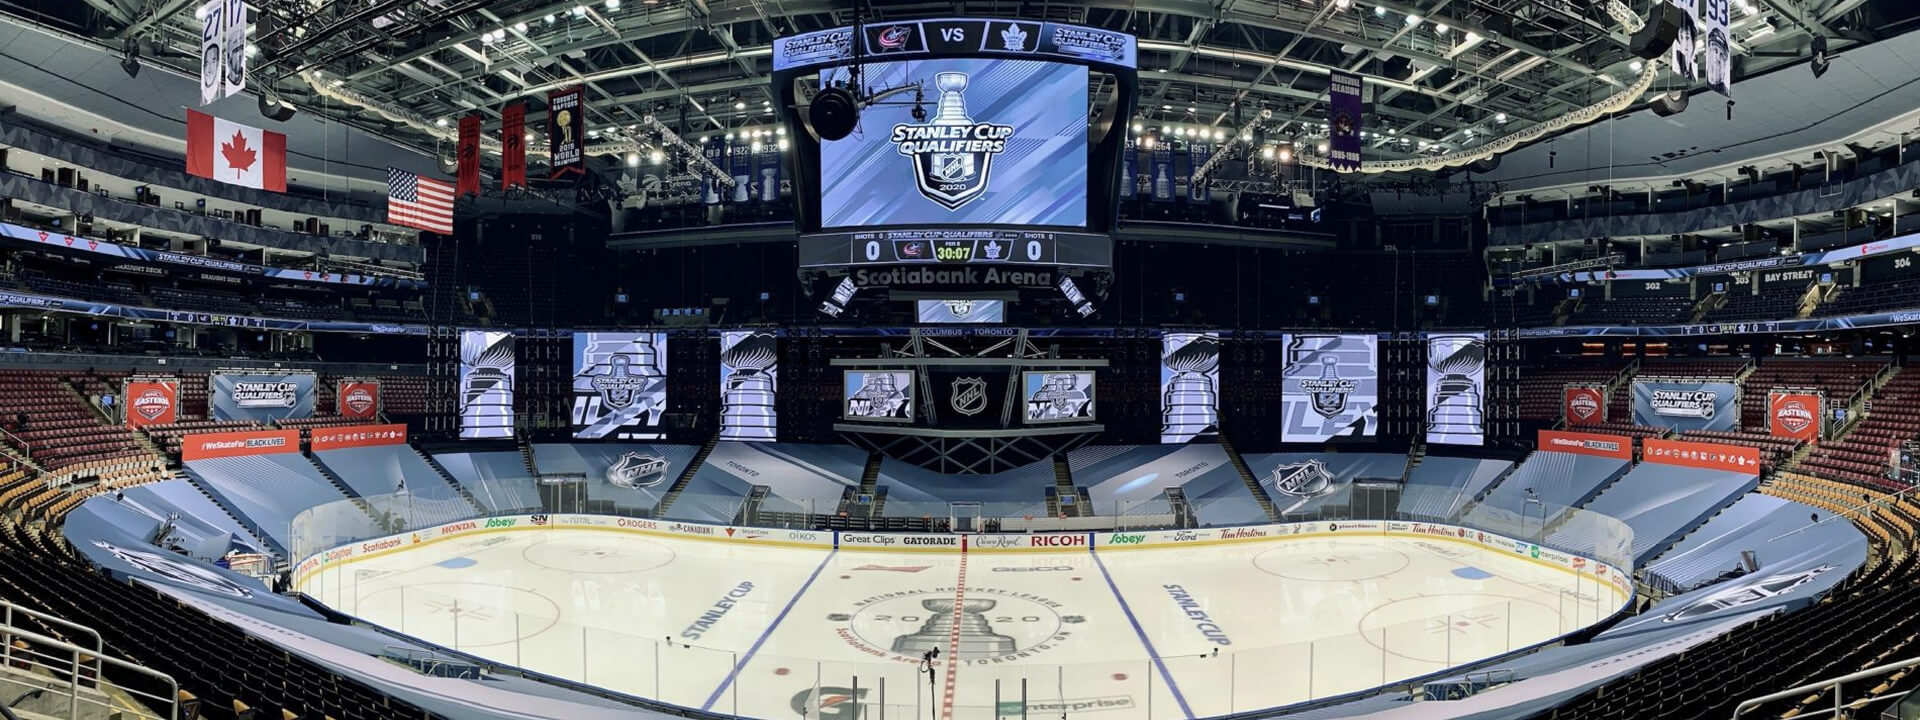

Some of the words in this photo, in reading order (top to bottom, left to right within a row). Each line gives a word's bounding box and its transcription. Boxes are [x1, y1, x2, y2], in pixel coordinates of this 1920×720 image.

[204, 8, 221, 43] 27
[941, 27, 965, 42] VS
[1056, 28, 1102, 42] STANLEY
[1103, 35, 1126, 46] CUP
[785, 34, 830, 49] STANLEY
[1054, 37, 1110, 50] QUALIFIERS
[893, 125, 973, 141] STANLEY
[974, 124, 1013, 140] CUP
[900, 140, 1004, 154] QUALIFIERS
[554, 149, 580, 160] WORLD
[866, 241, 880, 261] 0
[937, 247, 970, 259] 30:07
[1027, 241, 1041, 261] 0
[1895, 259, 1911, 269] 304
[857, 267, 978, 285] Scotiabank
[984, 268, 1050, 285] Arena
[1765, 273, 1781, 282] BAY
[1783, 270, 1814, 281] STREET
[1645, 282, 1660, 290] 302
[921, 328, 962, 336] COLUMBUS
[974, 328, 1013, 336] TORONTO
[235, 382, 278, 391] STANLEY
[278, 382, 297, 392] CUP
[235, 392, 283, 400] QUALIFIERS
[958, 388, 981, 407] NHL
[1653, 391, 1693, 400] STANLEY
[1694, 391, 1716, 401] CUP
[1652, 400, 1701, 409] QUALIFIERS
[247, 439, 268, 448] BLACK
[268, 438, 285, 446] LIVES
[1602, 442, 1618, 450] LIVES
[627, 462, 661, 478] NHL
[727, 460, 759, 477] TORONTO
[1175, 462, 1209, 478] TORONTO
[1285, 467, 1315, 490] NHL
[442, 522, 477, 534] HONDA
[485, 518, 517, 528] Sobeys
[627, 521, 657, 530] ROGERS
[684, 525, 710, 535] CANADIAN
[1174, 530, 1198, 541] Ford
[1220, 528, 1236, 540] Tim
[1236, 528, 1267, 539] Hortons
[1412, 523, 1426, 533] Tim
[1428, 524, 1455, 537] Hortons
[843, 534, 870, 543] Great
[873, 535, 895, 546] Clips
[903, 537, 957, 545] GATORADE
[1031, 535, 1085, 547] RICOH
[1109, 533, 1146, 544] Sobeys
[363, 537, 402, 553] Scotiabank
[853, 588, 923, 606] NATIONAL
[681, 596, 738, 640] STANLEY
[729, 581, 755, 598] CUP
[1163, 584, 1212, 622] STANLEY
[1196, 622, 1232, 646] CUP
[836, 626, 887, 657] Scotiabank
